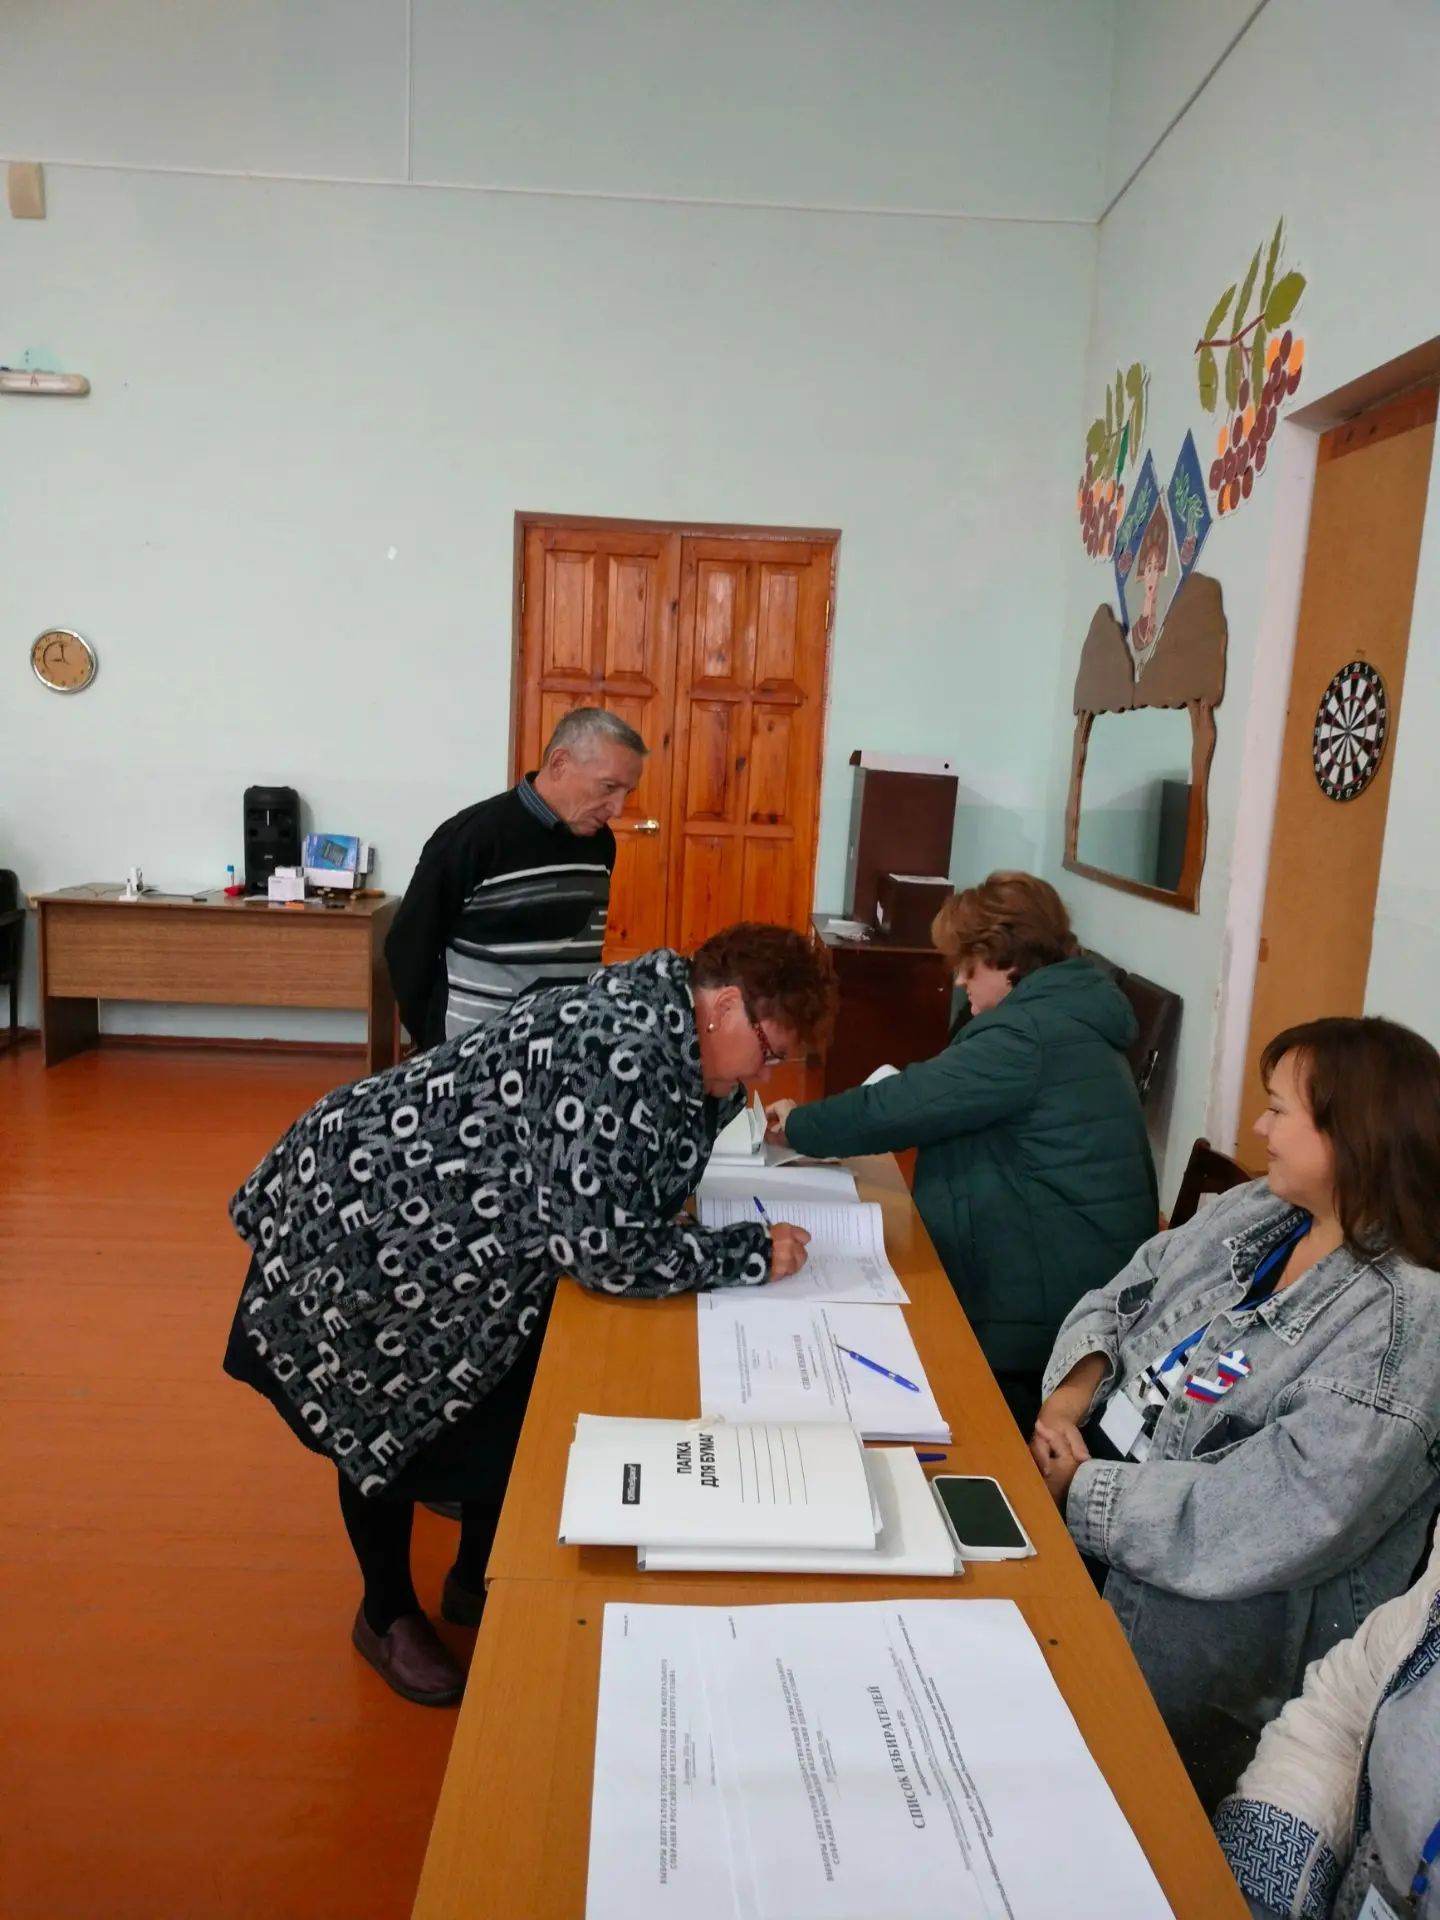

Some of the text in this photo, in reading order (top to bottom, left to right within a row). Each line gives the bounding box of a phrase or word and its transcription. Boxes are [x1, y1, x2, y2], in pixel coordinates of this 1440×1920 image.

[676, 1441, 692, 1474] ПАПКА
[699, 1433, 719, 1488] ДЛЯ БУМАГ
[867, 1686, 906, 1773] ИЗБИРАТЕЛЕЙ
[897, 1776, 926, 1829] СПИСОК
